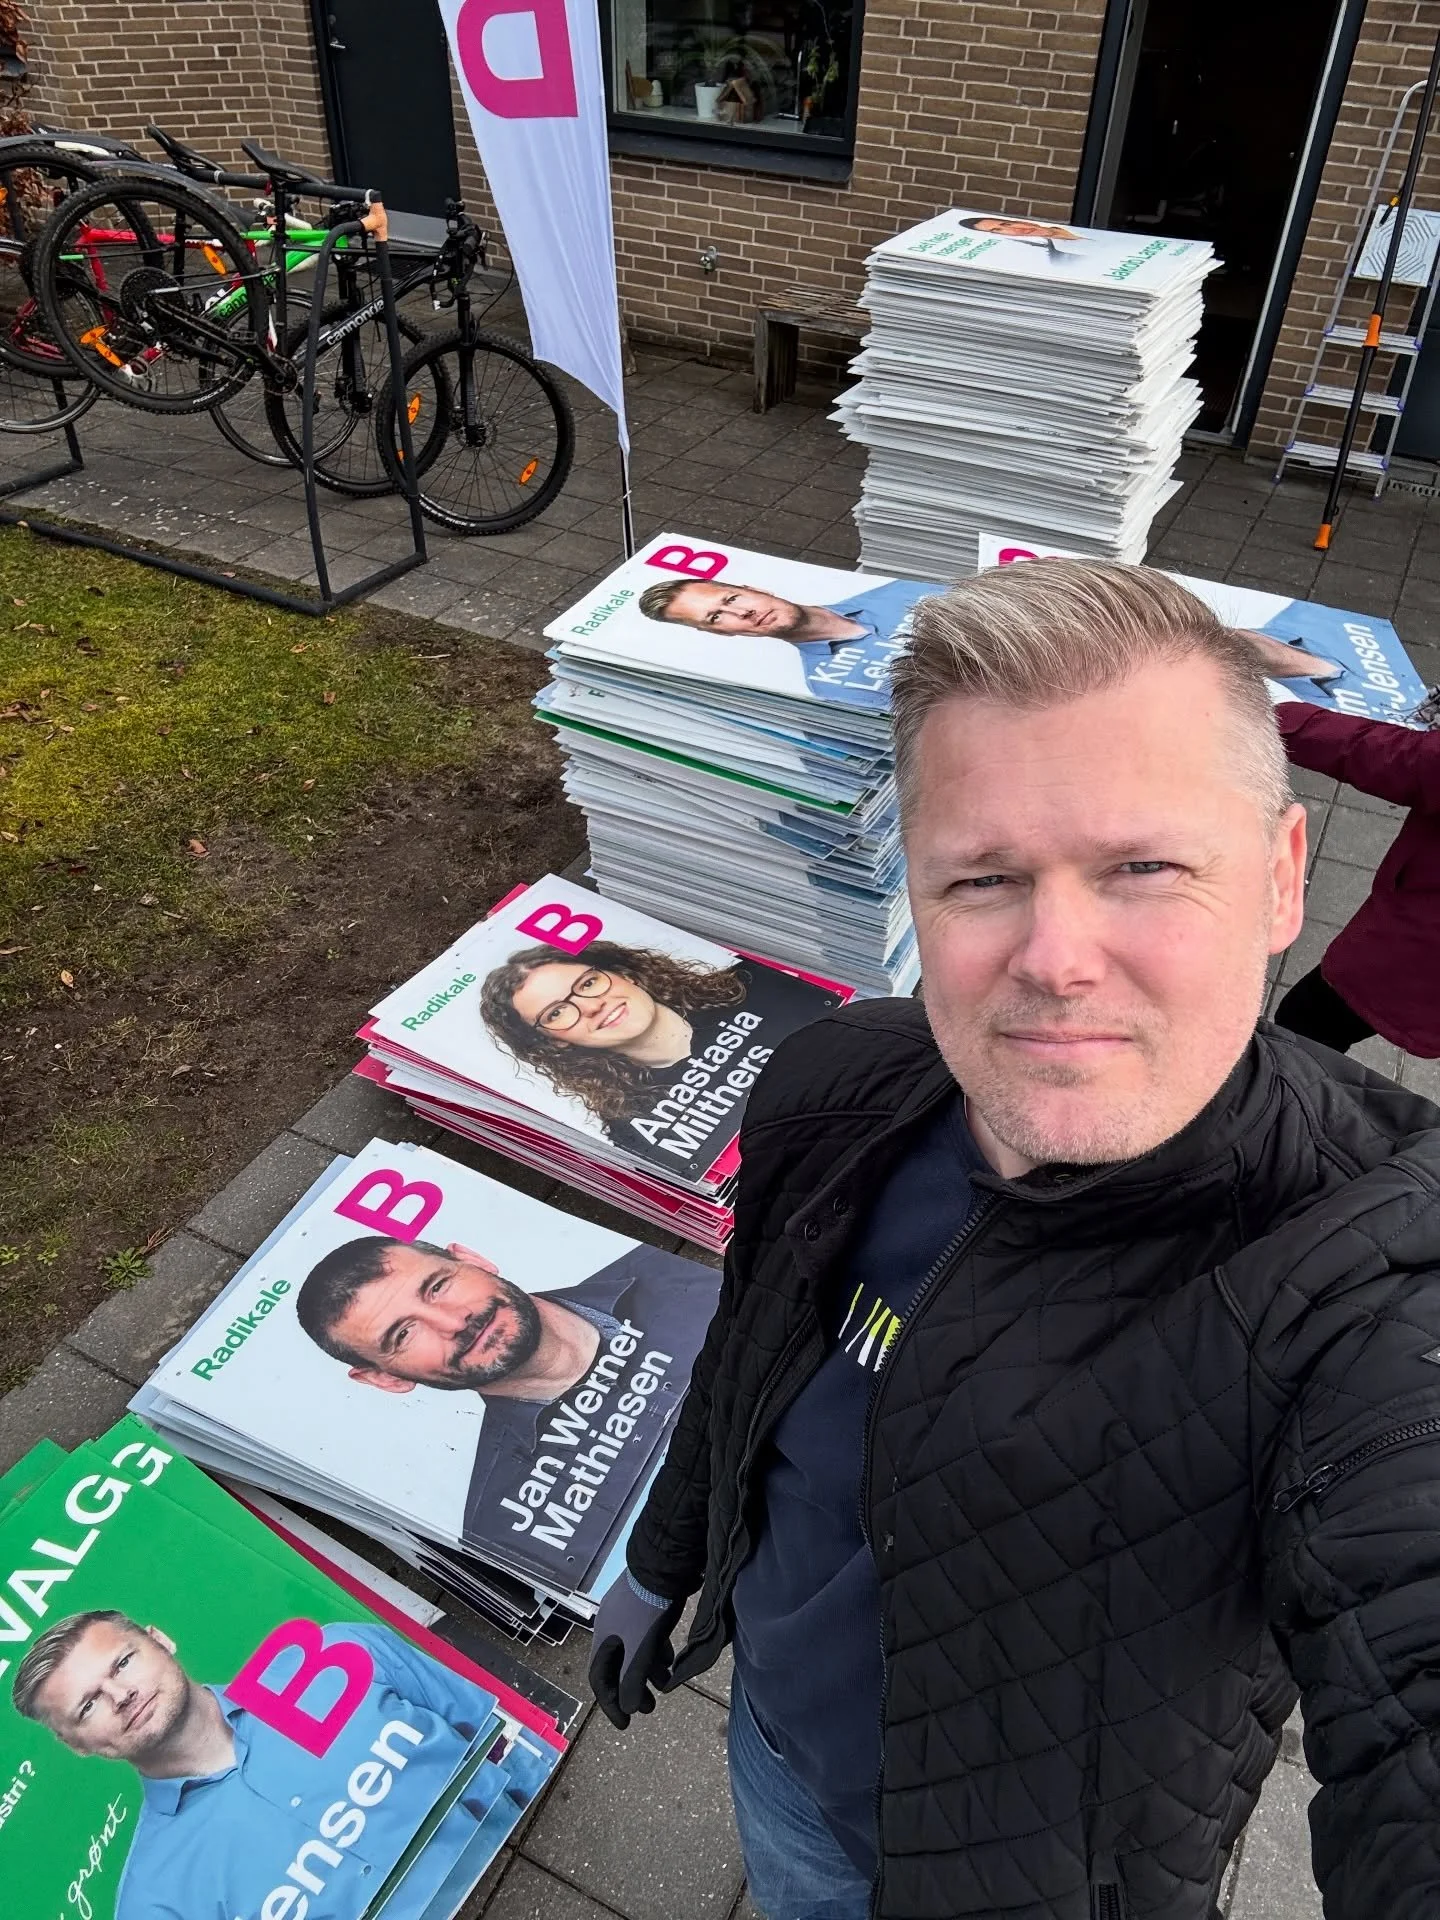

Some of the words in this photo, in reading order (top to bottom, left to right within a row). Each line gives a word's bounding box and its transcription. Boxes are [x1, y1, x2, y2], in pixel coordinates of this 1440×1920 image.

[572, 587, 635, 637] Radikale
[645, 545, 729, 580] B
[808, 647, 865, 685] Kim
[516, 903, 604, 956] B
[401, 971, 477, 1032] Radikale
[629, 1008, 764, 1146] Anastasia
[657, 1044, 775, 1162] Milthers
[334, 1168, 444, 1245] B
[190, 1279, 292, 1382] Radikale
[499, 1454, 566, 1533] Jan
[540, 1318, 646, 1447] Werner
[530, 1349, 673, 1551] Mathiasen
[223, 1617, 375, 1760] B
[67, 1792, 127, 1920] grønt
[250, 1720, 425, 1920] ensen
